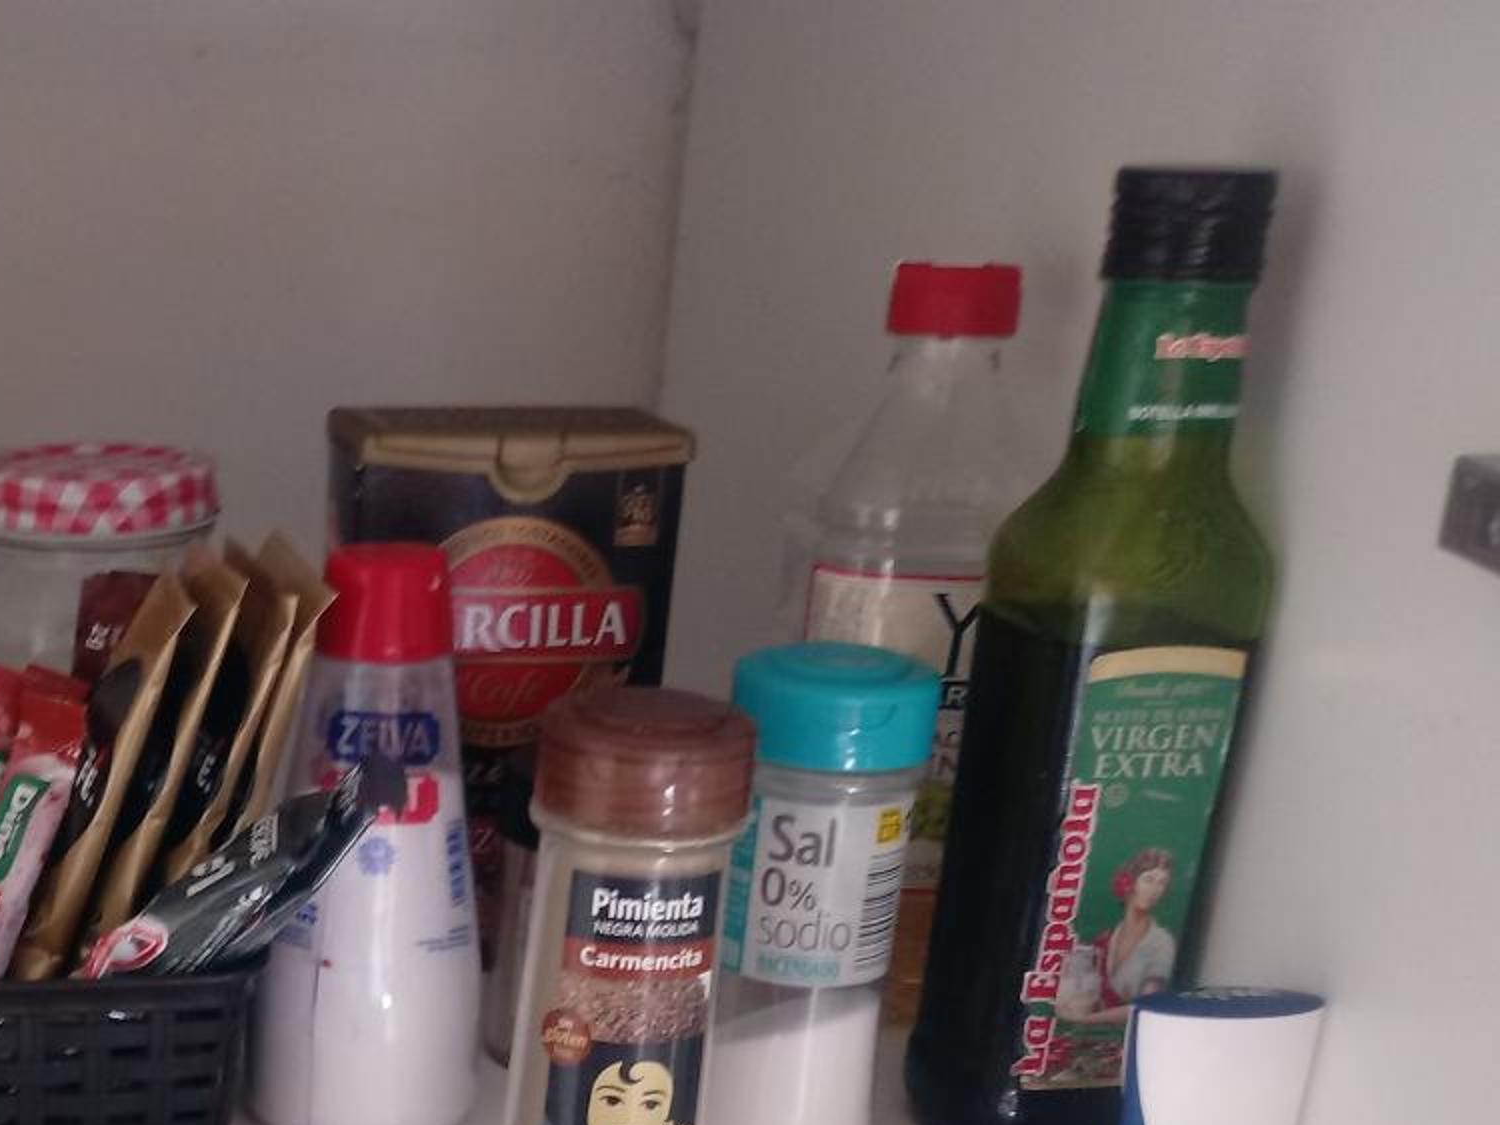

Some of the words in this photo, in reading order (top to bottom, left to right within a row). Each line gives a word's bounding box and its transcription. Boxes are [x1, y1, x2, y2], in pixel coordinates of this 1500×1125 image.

[1092, 725, 1218, 751] VIRGEN
[1093, 752, 1204, 779] EXTRA
[769, 814, 837, 867] Sal
[590, 886, 704, 922] Pimienta
[761, 866, 817, 911] 0%
[1023, 783, 1100, 1003] Española
[593, 920, 644, 940] NEGRA
[646, 919, 700, 939] MOLIDA
[755, 911, 853, 952] sodio
[579, 946, 704, 974] Carmencita
[1011, 1013, 1057, 1078] La
